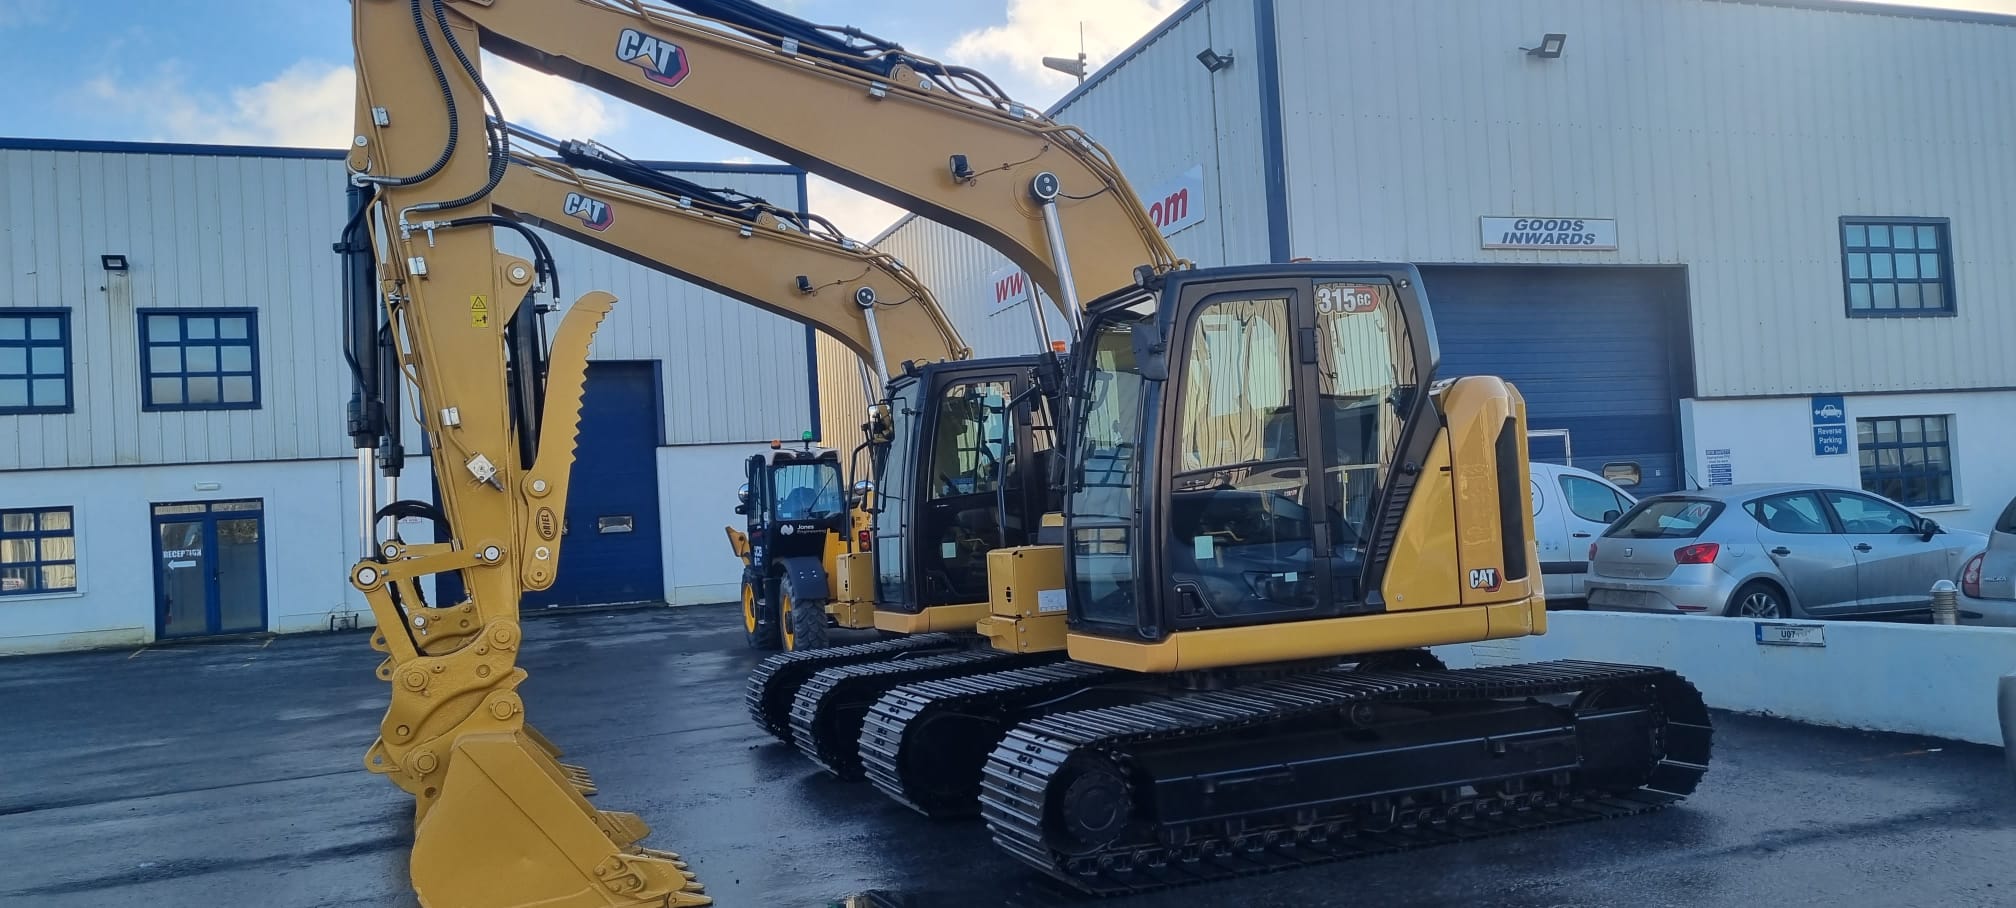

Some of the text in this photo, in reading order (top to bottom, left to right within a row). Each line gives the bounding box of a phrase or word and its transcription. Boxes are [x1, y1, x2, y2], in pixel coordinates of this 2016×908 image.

[617, 29, 677, 75] CAT
[564, 193, 605, 224] CAT
[1513, 218, 1585, 232] GOODS
[1501, 231, 1596, 245] INWARDS
[1817, 427, 1843, 435] Reverse
[1819, 437, 1843, 445] Parking
[1824, 445, 1839, 454] Only
[541, 513, 552, 535] ORIEL
[163, 549, 202, 559] RECEPTION
[1470, 569, 1494, 588] CAT
